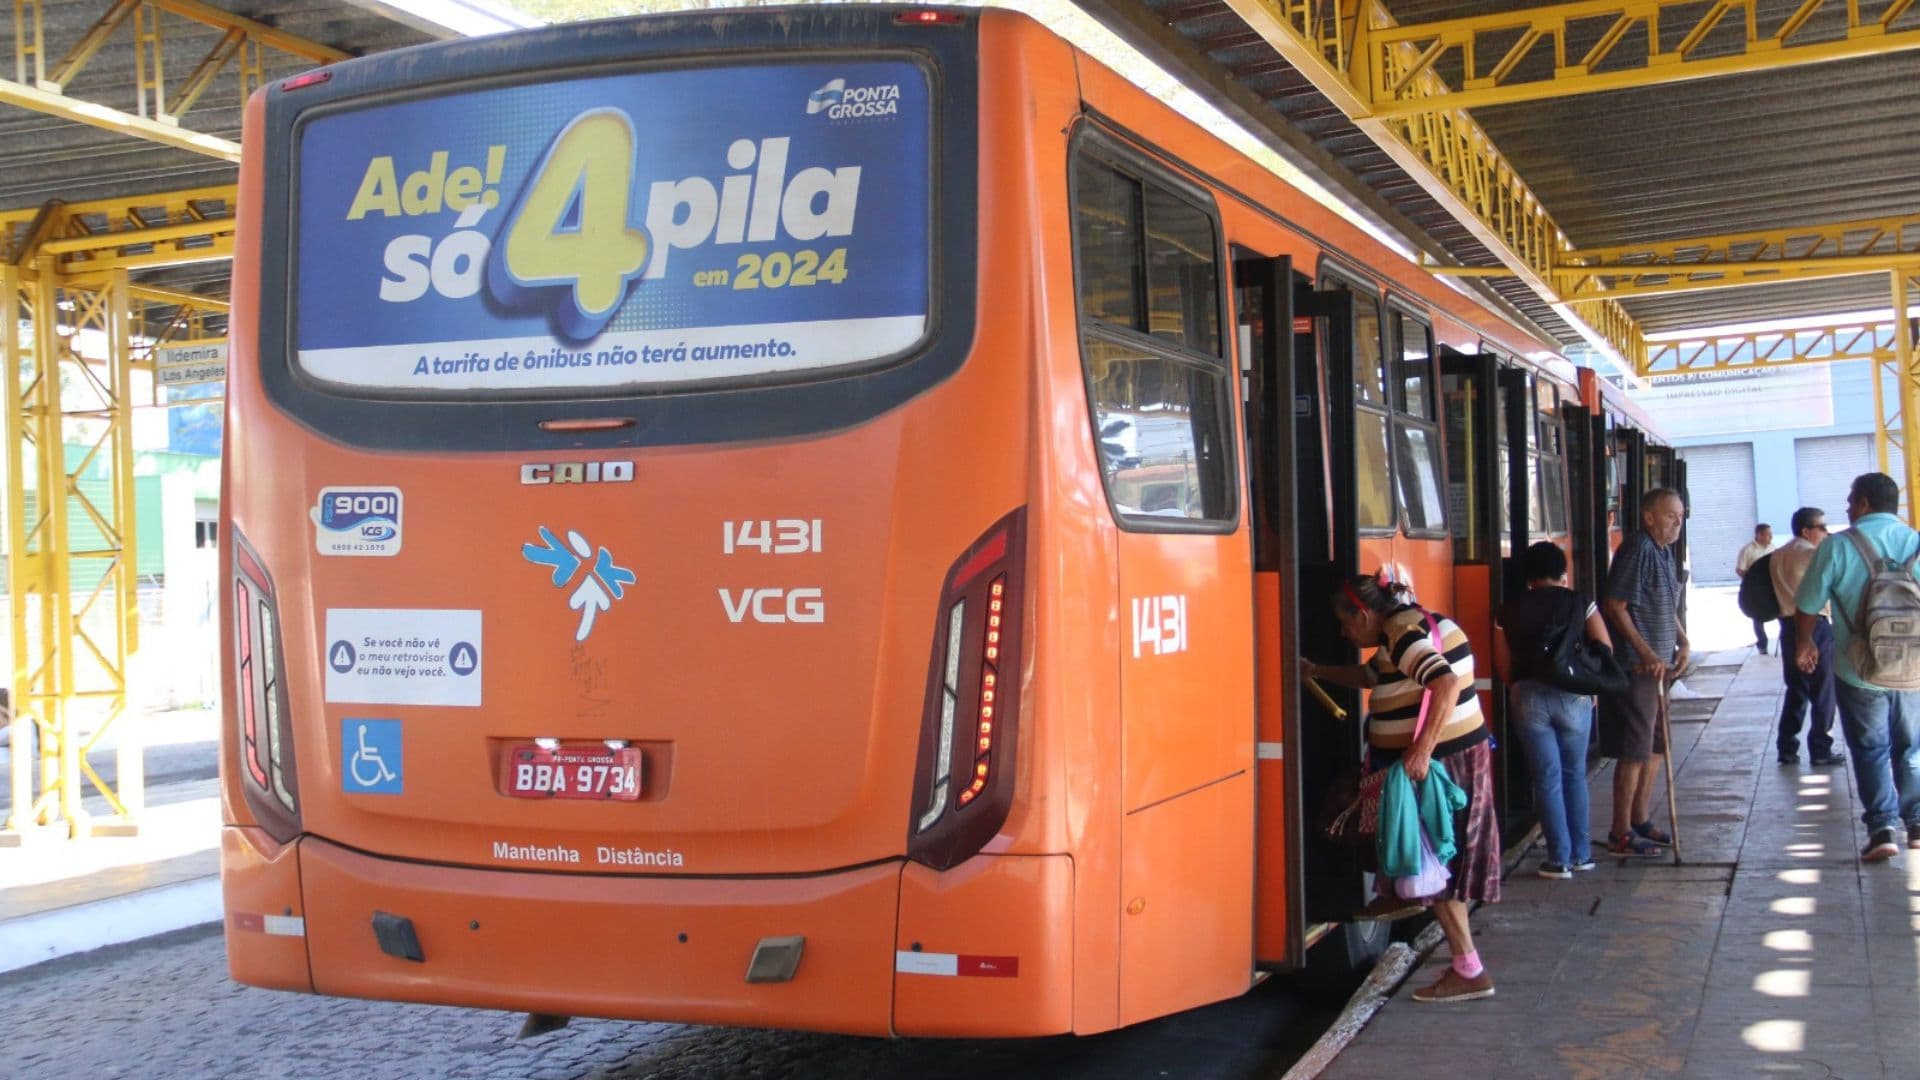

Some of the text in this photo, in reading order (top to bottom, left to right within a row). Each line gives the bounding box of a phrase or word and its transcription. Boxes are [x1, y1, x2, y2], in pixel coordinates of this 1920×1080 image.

[843, 85, 900, 103] PONTA
[828, 100, 897, 119] GROSSA
[346, 144, 507, 220] Ade!
[379, 107, 862, 320] só 4 pila
[693, 248, 848, 290] em 2024
[413, 338, 796, 375] A tarifa de ônibus não terá aumento.
[163, 370, 182, 381] Los
[520, 461, 635, 484] CAIO
[335, 496, 395, 514] 9001
[361, 526, 383, 536] VCG
[723, 519, 822, 554] 1431
[718, 587, 824, 623] VCG
[1132, 594, 1187, 658] 1431
[363, 637, 440, 648] Se você não vê
[359, 652, 445, 662] o meu retrovisor
[357, 666, 447, 679] eu não vejo você.
[516, 764, 636, 793] BBA 9734
[493, 841, 684, 866] Mantenha Distância
